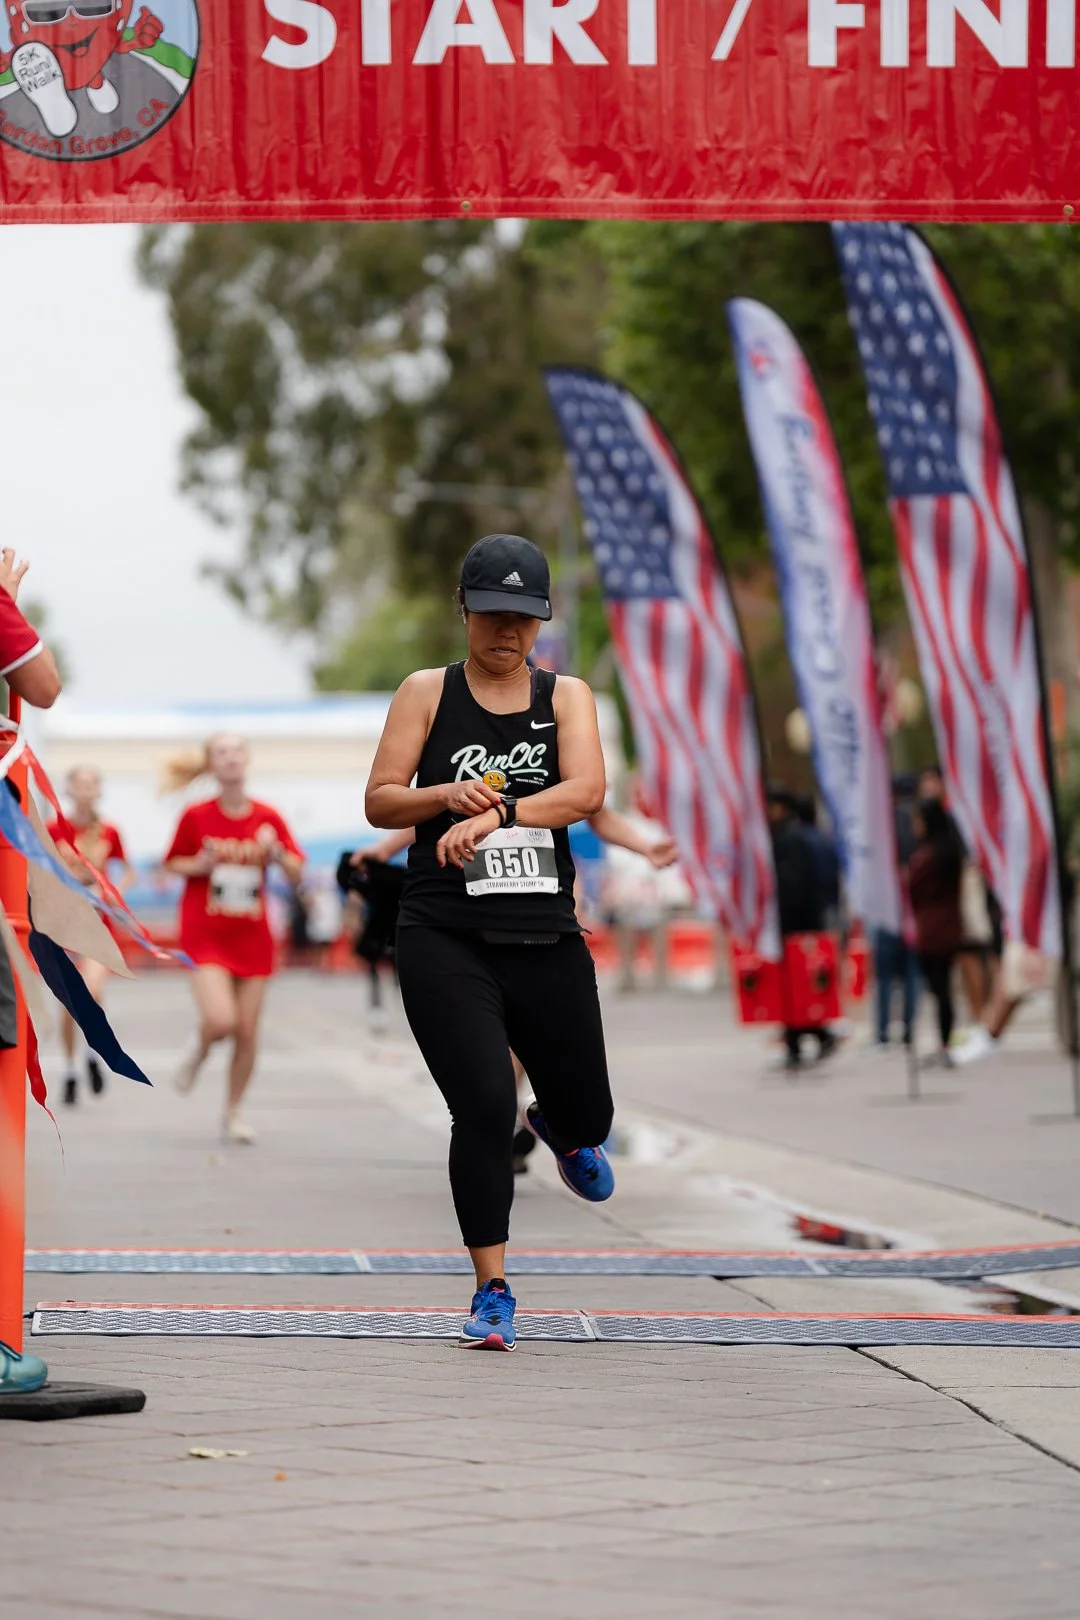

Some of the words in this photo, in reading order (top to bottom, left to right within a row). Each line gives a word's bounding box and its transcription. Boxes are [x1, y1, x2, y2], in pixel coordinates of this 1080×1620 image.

[137, 98, 168, 127] CA
[450, 741, 548, 784] RunOC
[485, 847, 540, 878] 650
